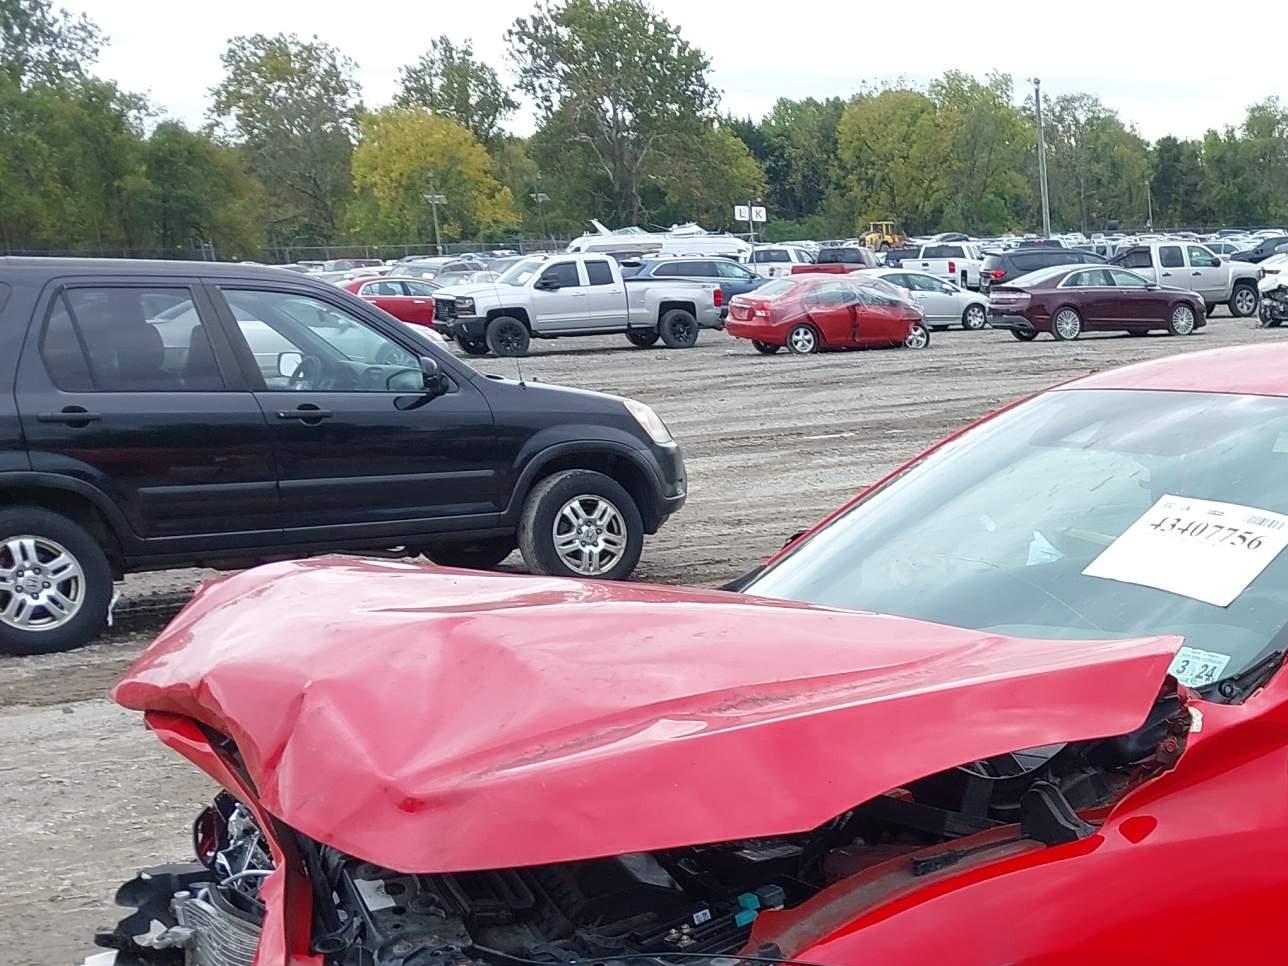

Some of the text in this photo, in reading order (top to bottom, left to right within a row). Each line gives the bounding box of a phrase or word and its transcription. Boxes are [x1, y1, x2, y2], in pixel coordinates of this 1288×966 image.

[1150, 516, 1266, 550] 43407756
[1176, 660, 1217, 680] 3 24
